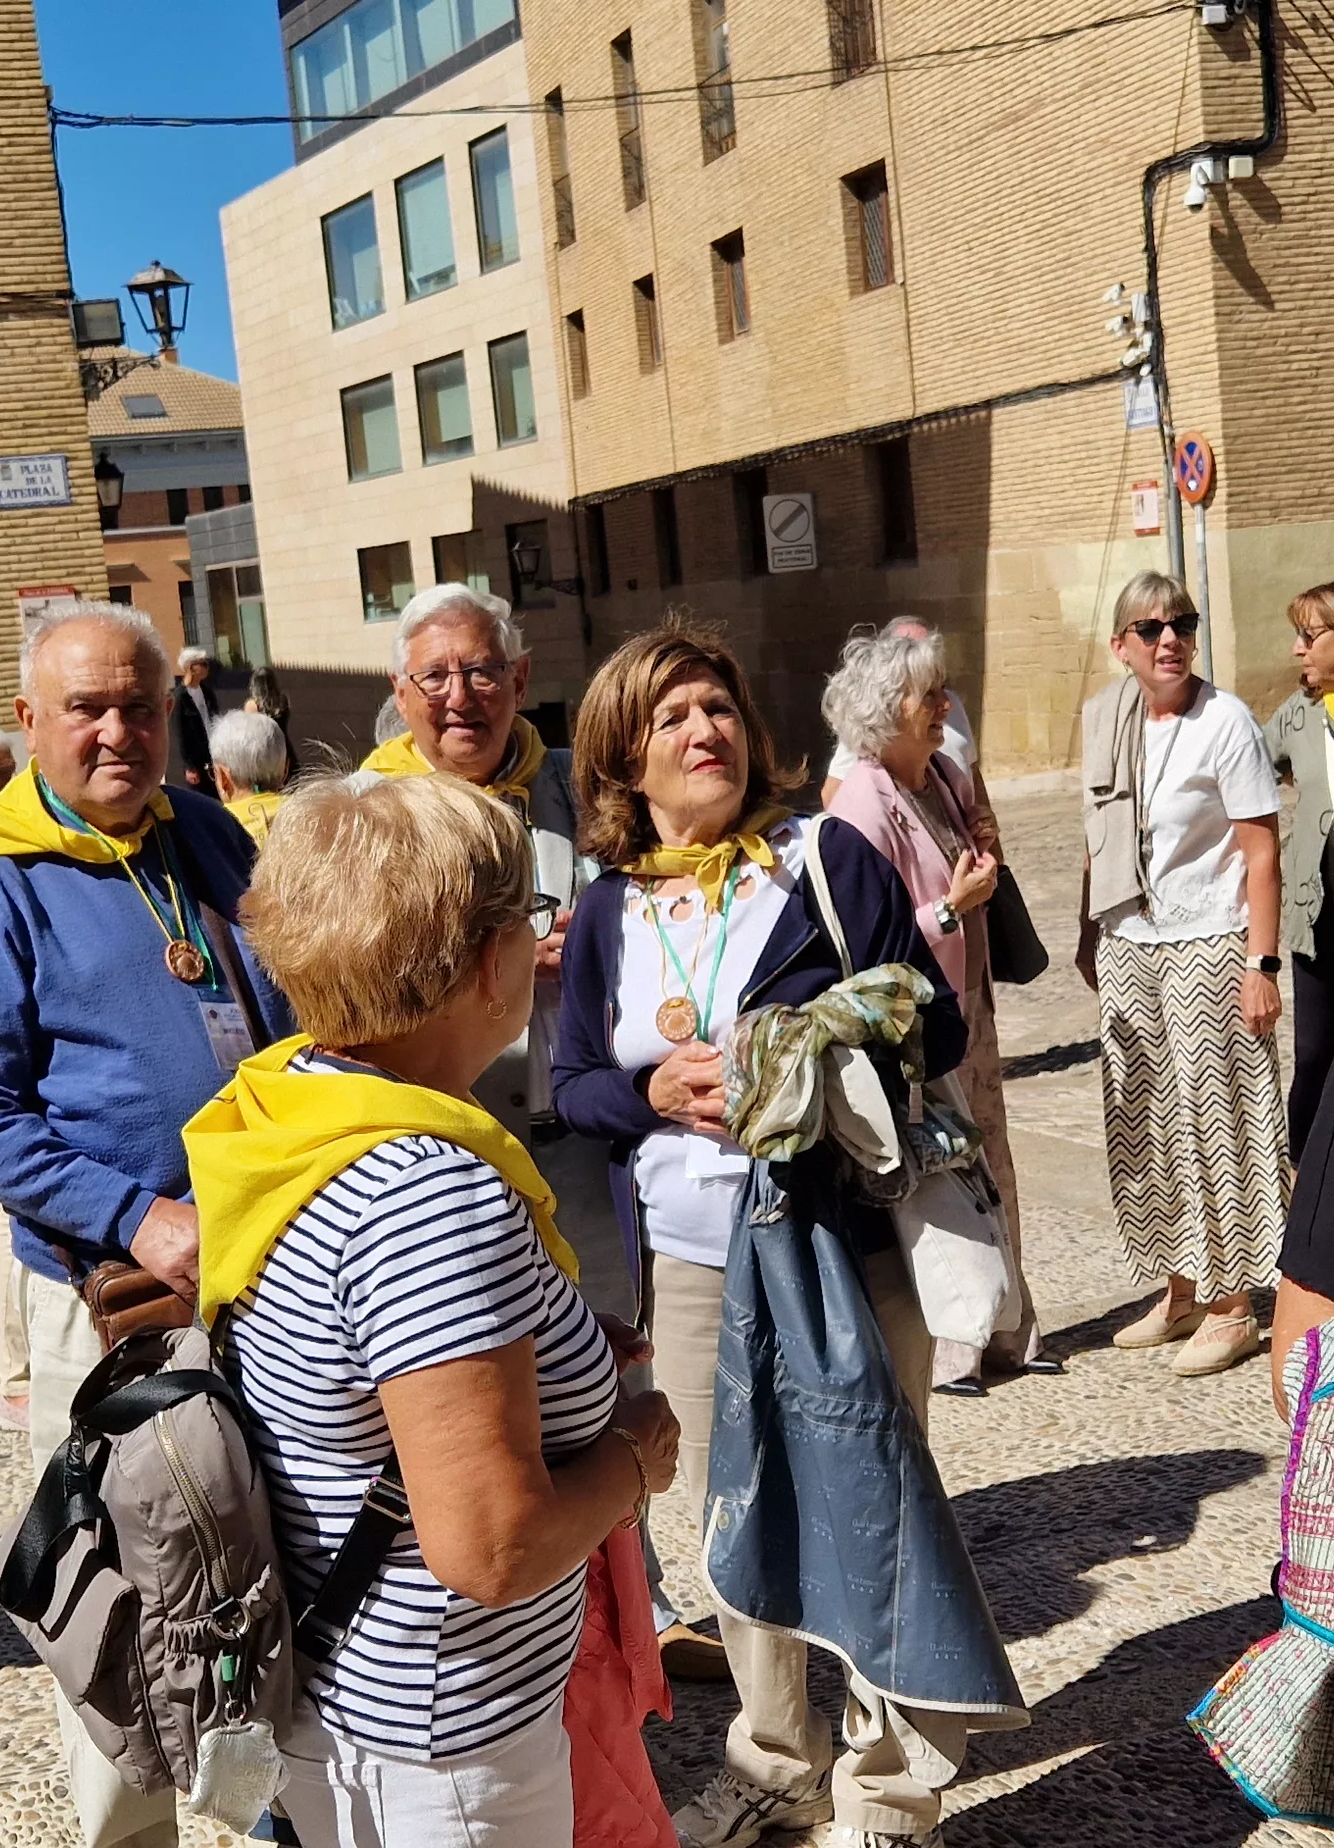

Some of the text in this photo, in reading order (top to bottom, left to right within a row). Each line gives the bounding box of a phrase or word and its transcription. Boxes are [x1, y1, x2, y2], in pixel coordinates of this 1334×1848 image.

[20, 464, 53, 475] PLAZA
[25, 476, 52, 486] DE LA
